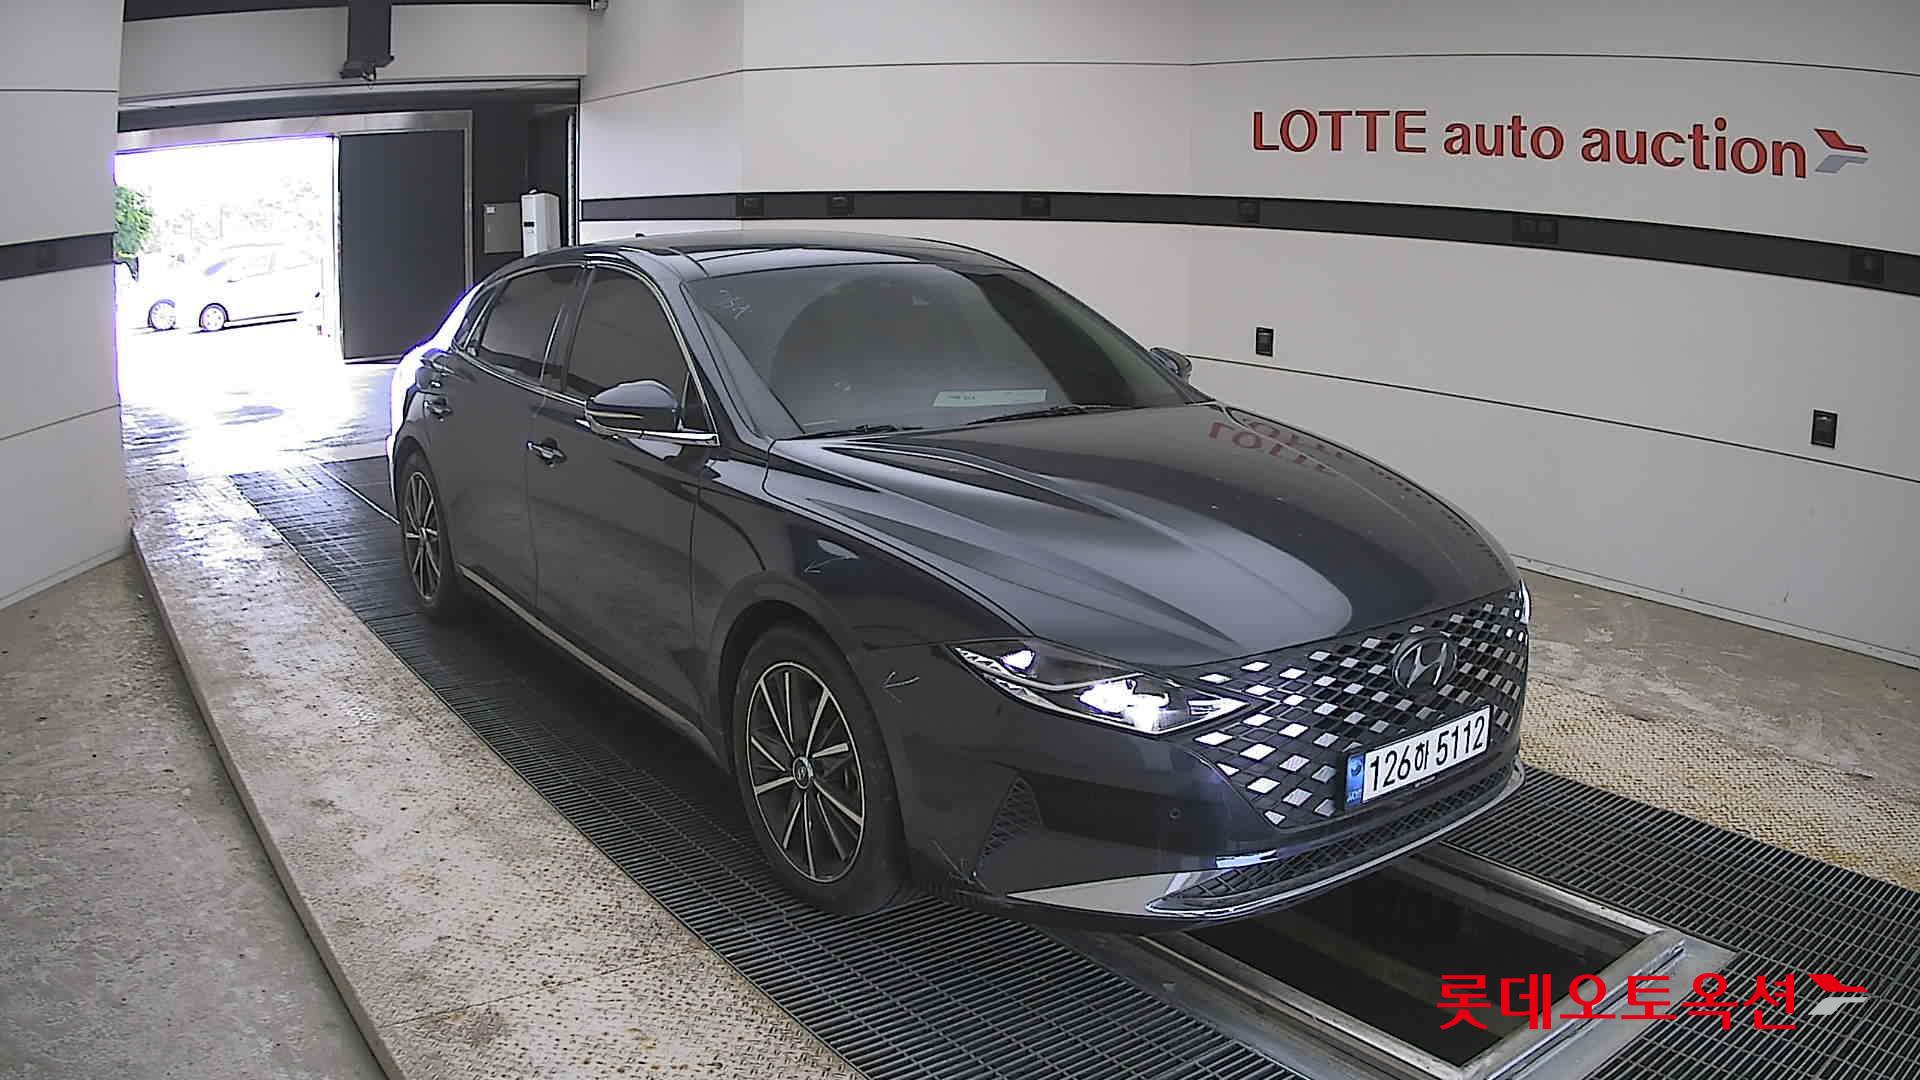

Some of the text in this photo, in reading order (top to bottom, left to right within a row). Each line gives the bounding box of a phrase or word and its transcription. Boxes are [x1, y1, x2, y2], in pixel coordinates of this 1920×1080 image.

[1252, 109, 1807, 178] LOTTE auto auction
[1370, 715, 1485, 792] 126하 5112
